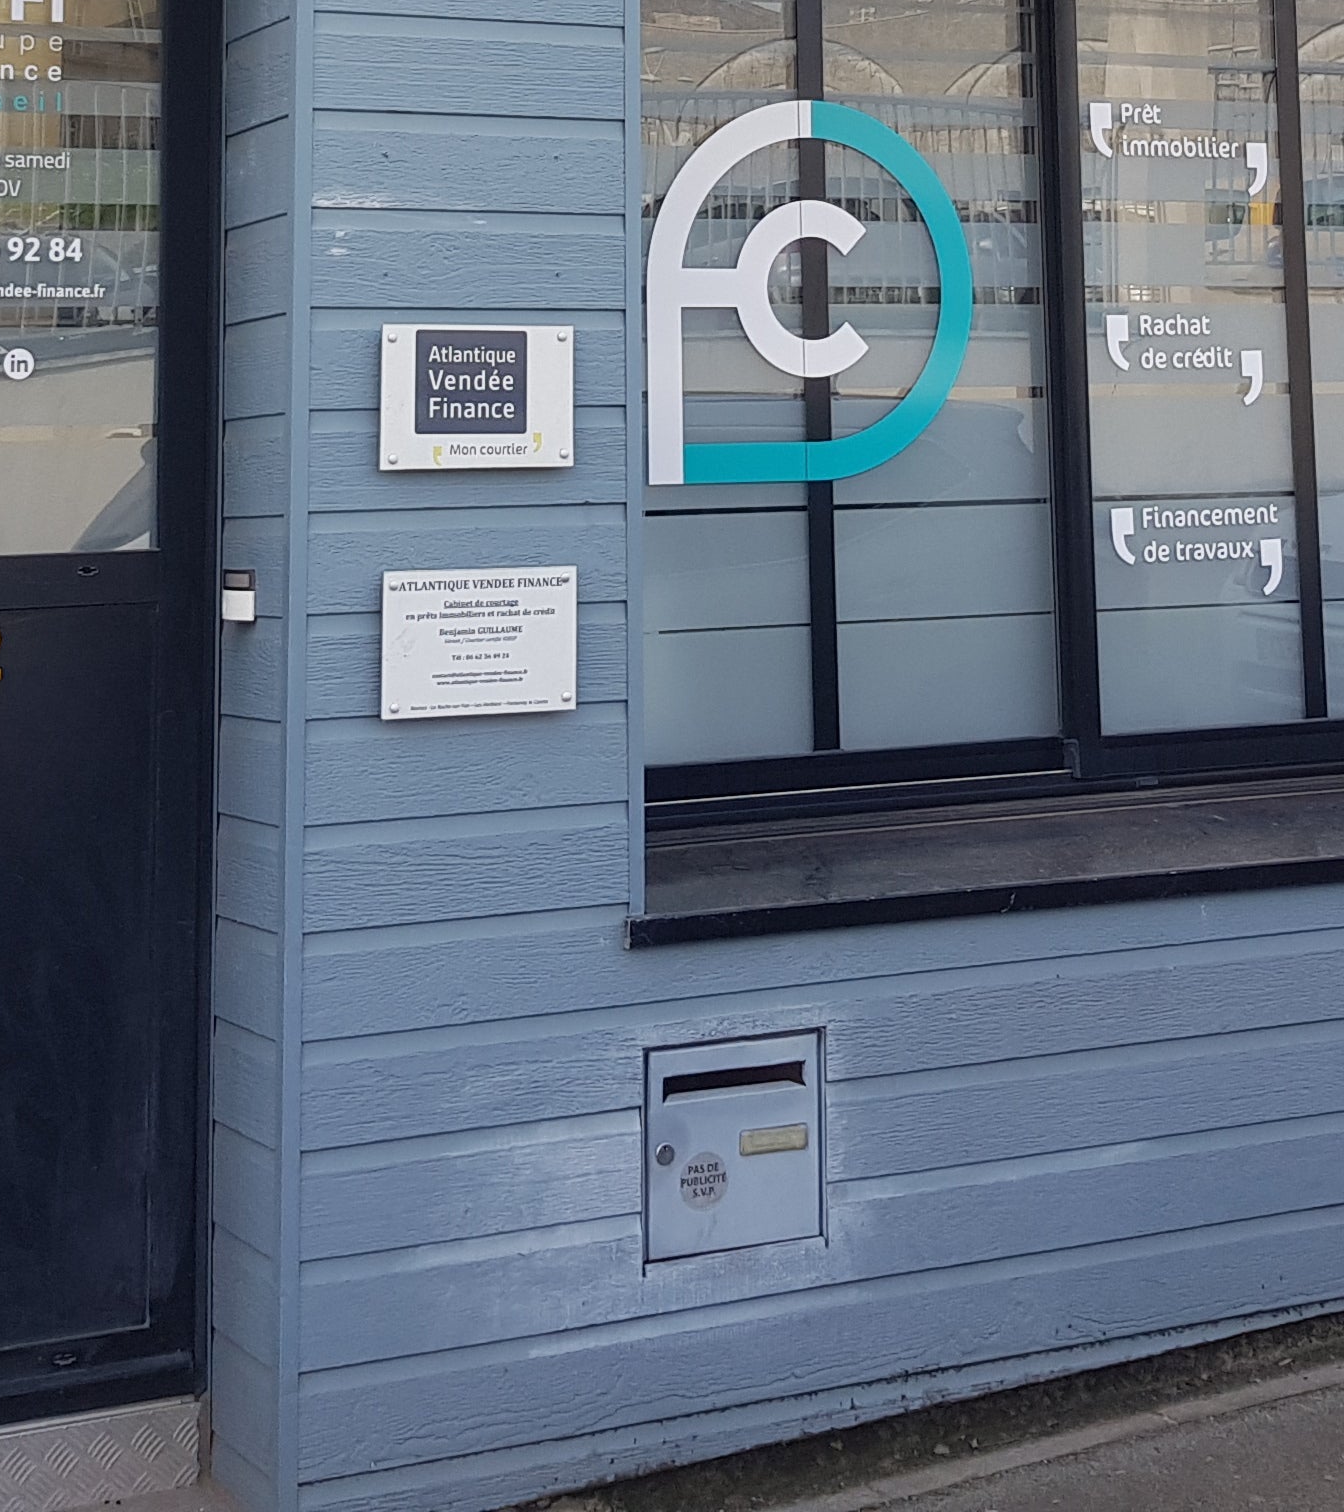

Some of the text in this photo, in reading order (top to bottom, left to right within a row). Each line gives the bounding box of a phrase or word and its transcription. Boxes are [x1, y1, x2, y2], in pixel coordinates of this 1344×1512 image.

[1121, 104, 1161, 124] Prêt
[1122, 136, 1238, 158] immobilier
[5, 151, 71, 169] samedi
[7, 237, 41, 262] 92
[49, 237, 82, 262] 84
[1139, 315, 1210, 336] Rachat
[428, 346, 516, 366] Atlantique
[1141, 346, 1233, 369] de crédit
[428, 369, 514, 391] Vendée
[429, 398, 515, 419] Finance
[450, 443, 528, 455] Mon courtier
[1142, 504, 1278, 529] Financement
[1144, 540, 1255, 563] de travaux
[399, 576, 562, 592] ATLANTIQUE VENDEE FINANCE
[688, 1162, 719, 1175] PAS DE
